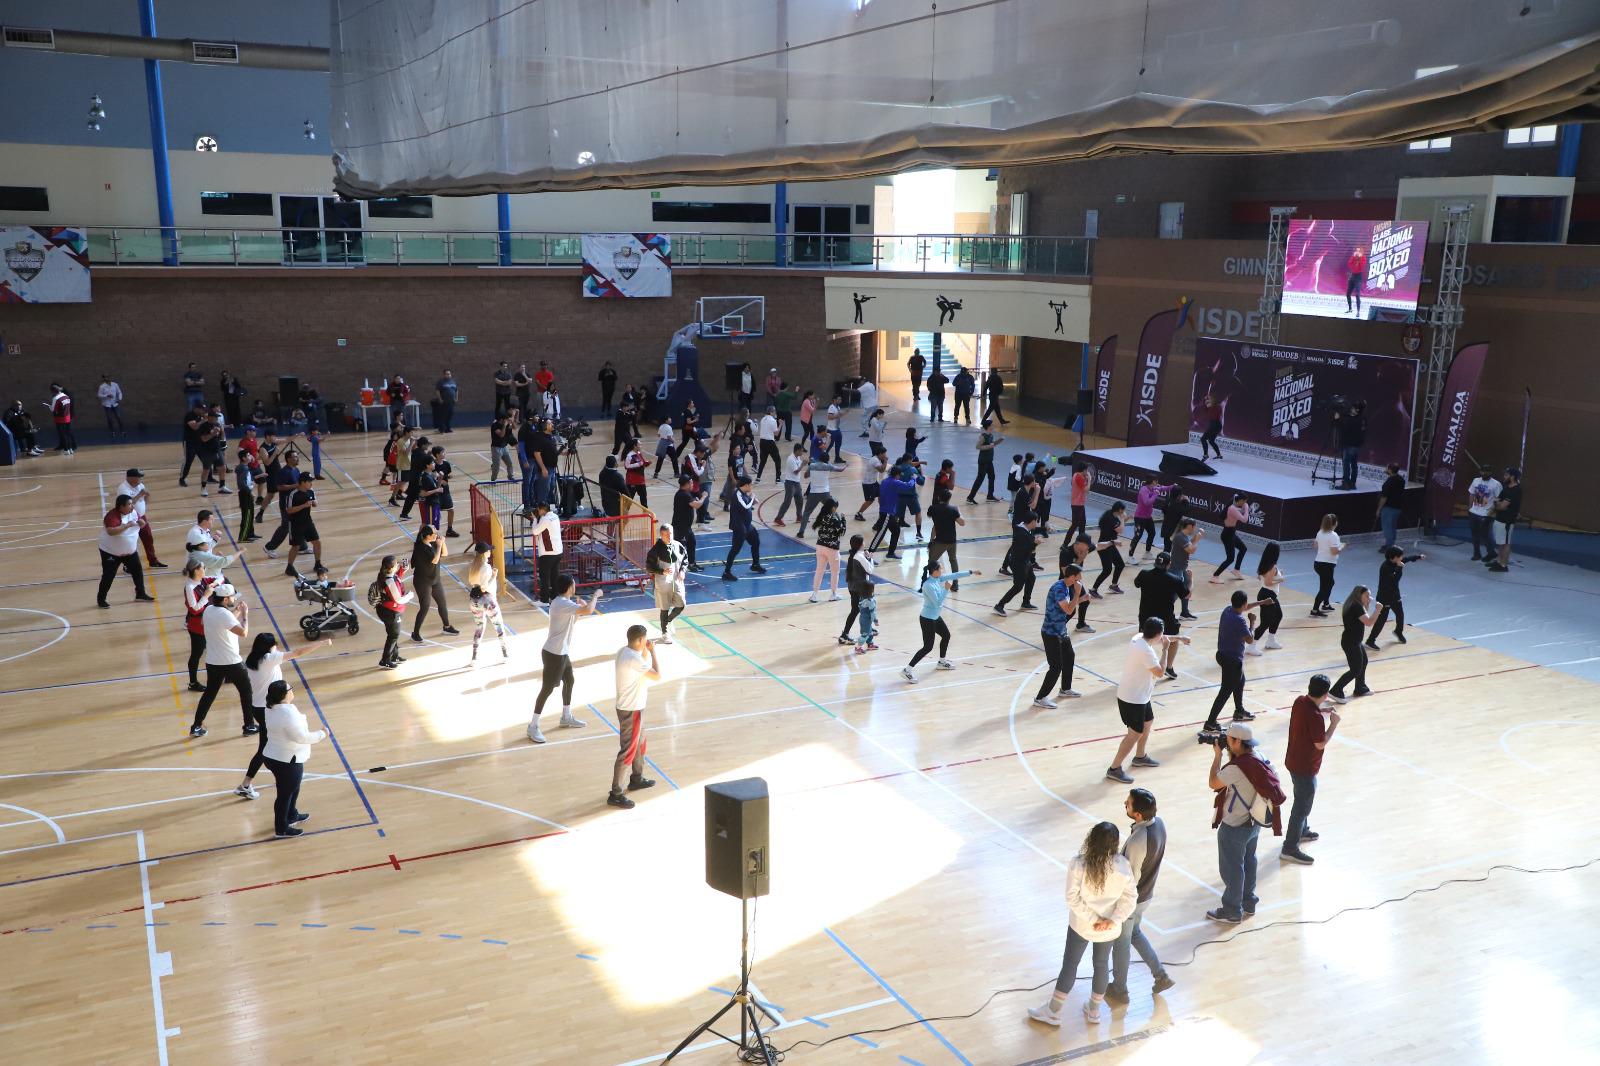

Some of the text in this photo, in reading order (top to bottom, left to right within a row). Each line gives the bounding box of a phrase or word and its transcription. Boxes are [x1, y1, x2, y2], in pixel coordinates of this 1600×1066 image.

[1370, 226, 1413, 257] NACIONAL
[1372, 228, 1392, 243] CLASE
[1368, 248, 1410, 280] BOXEO
[1198, 307, 1260, 337] ISDE
[1331, 358, 1345, 366] ISDE
[1098, 369, 1111, 400] ISDE
[1140, 353, 1162, 406] ISDE
[1274, 373, 1294, 387] CLASE
[1274, 374, 1314, 402] NACIONAL
[1272, 396, 1313, 426] BOXEO
[1442, 391, 1467, 464] SINALOA
[1097, 475, 1121, 489] México
[1248, 515, 1265, 526] WBC
